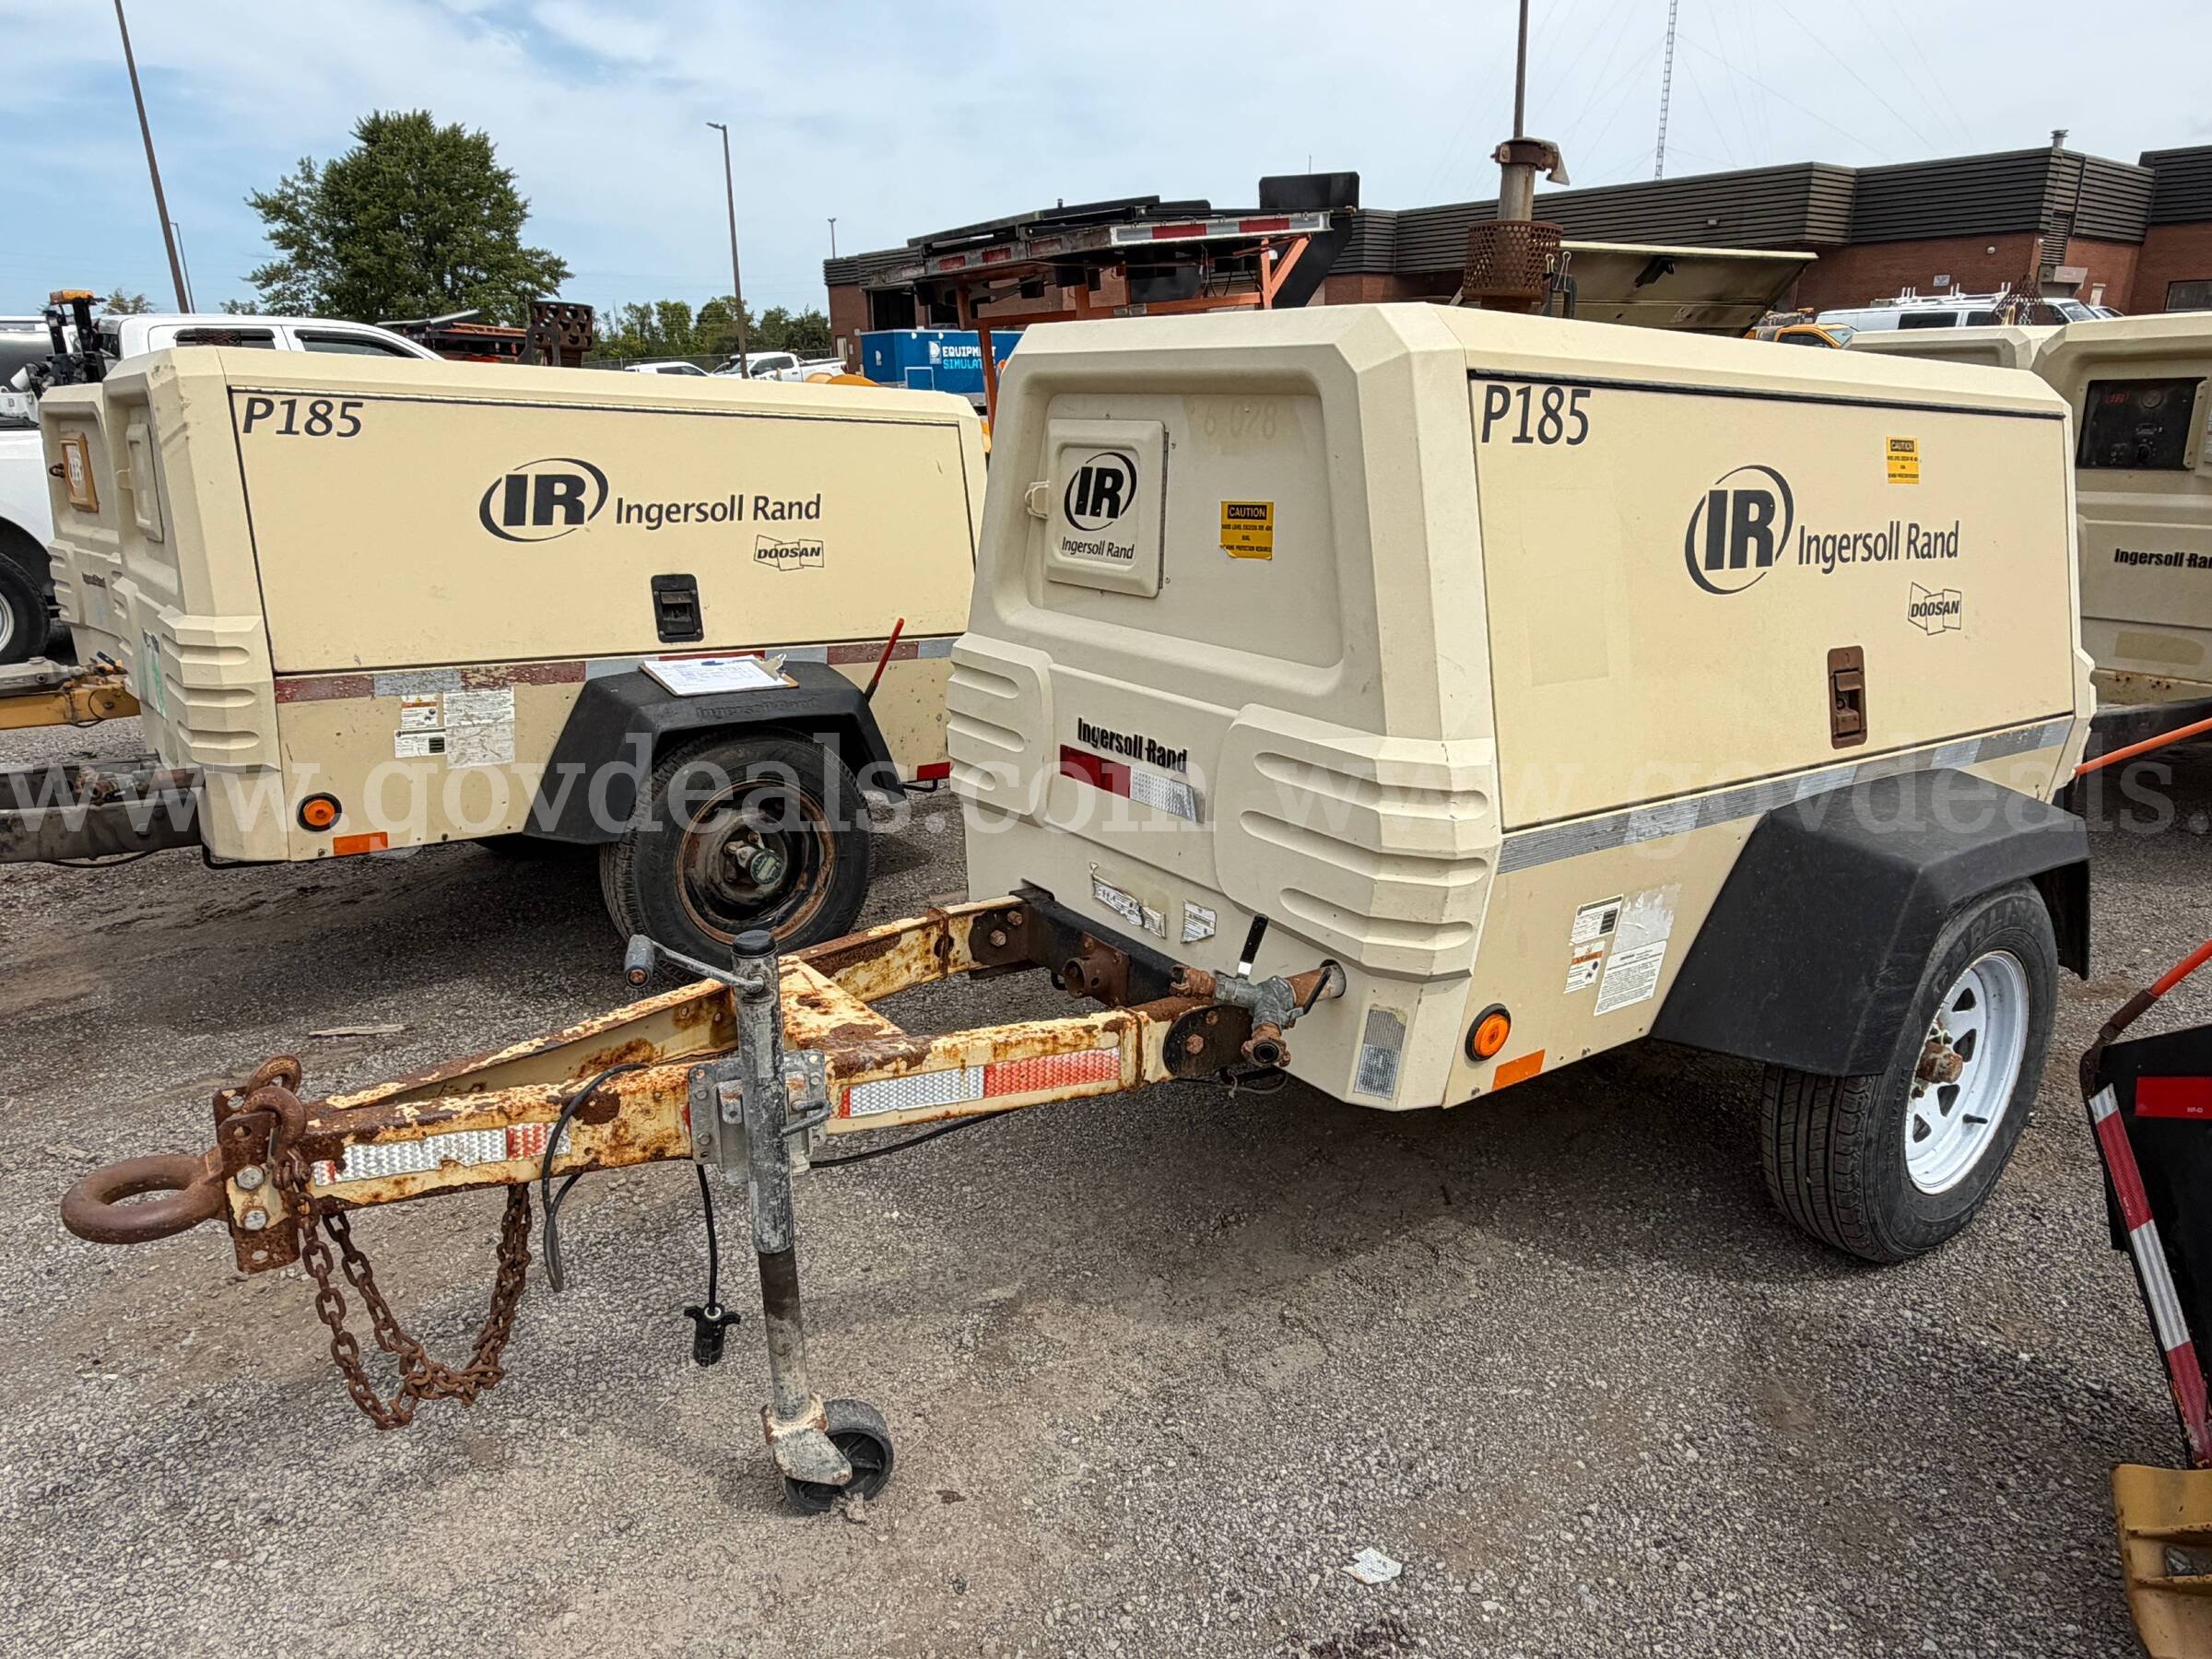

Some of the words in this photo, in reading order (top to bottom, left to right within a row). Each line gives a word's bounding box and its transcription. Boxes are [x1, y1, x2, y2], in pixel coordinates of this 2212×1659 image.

[942, 346, 996, 358] EQUIPMT
[242, 396, 364, 438] P185
[1481, 384, 1591, 446] P185
[502, 474, 587, 526] IR
[1075, 465, 1124, 519] IR
[1228, 506, 1266, 518] CAUTION
[616, 493, 744, 532] Ingersoll
[752, 493, 822, 523] Rand
[1704, 488, 1777, 571] IR
[756, 545, 822, 561] DOOSAN
[1062, 536, 1105, 557] Ingersoll
[1107, 541, 1135, 559] Rand
[1798, 521, 1900, 575] Ingersoll
[1906, 519, 1960, 560] Rand
[2113, 547, 2185, 568] Ingersoll
[1911, 599, 1960, 618] DOOSAN
[1077, 717, 1144, 760] Ingersoll
[1144, 738, 1188, 774] Rand
